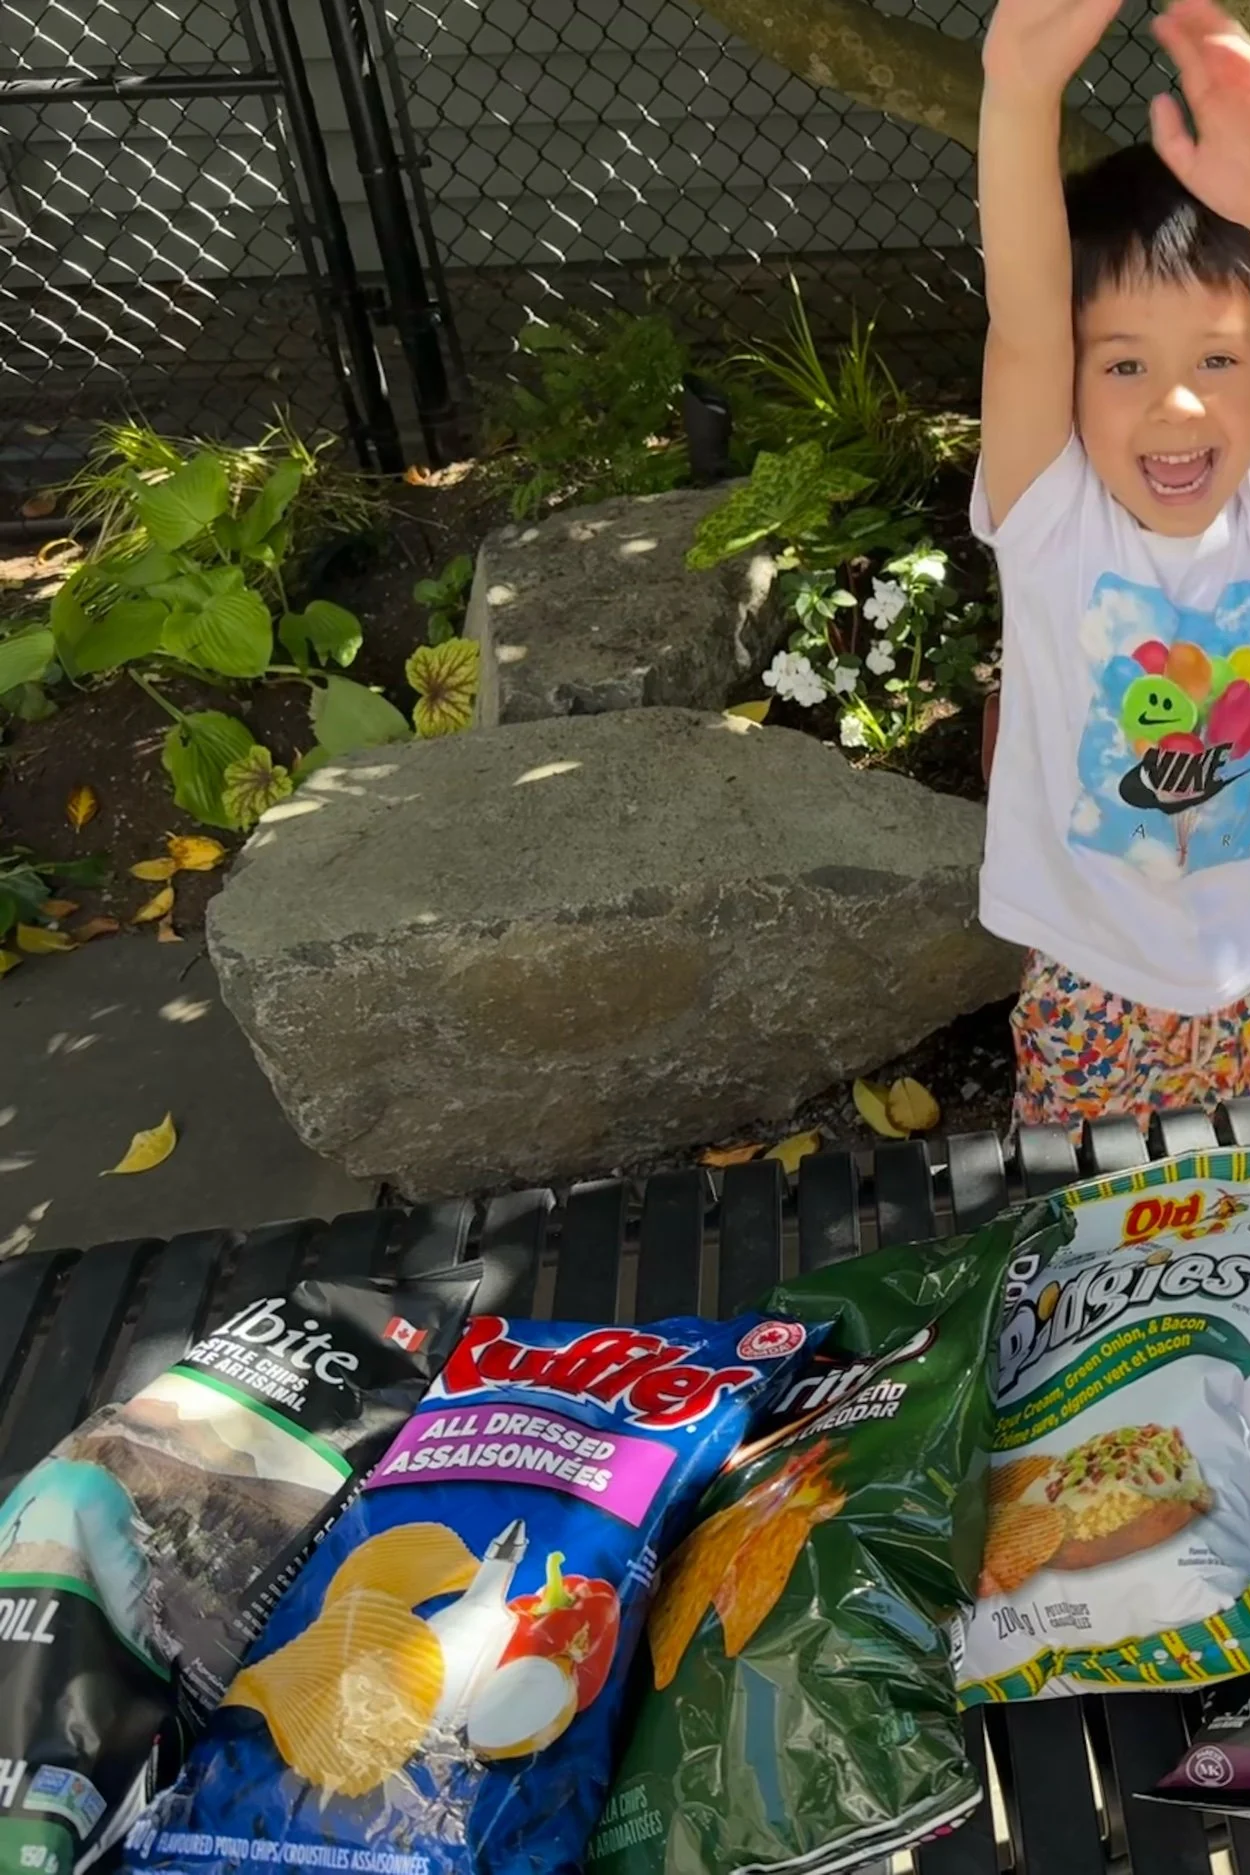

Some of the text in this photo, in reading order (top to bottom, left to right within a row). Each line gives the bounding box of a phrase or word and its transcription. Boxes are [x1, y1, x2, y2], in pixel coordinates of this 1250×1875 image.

[1148, 742, 1232, 793] NIKE
[1124, 1189, 1203, 1238] Old
[255, 1358, 310, 1391] CHIPS
[1060, 1381, 1104, 1419] oignon
[1103, 1361, 1132, 1386] vert
[1133, 1351, 1147, 1368] et
[1147, 1333, 1192, 1358] bacon
[1064, 1353, 1102, 1389] Green
[1100, 1327, 1147, 1358] Onion,
[1148, 1320, 1160, 1335] &
[1161, 1316, 1206, 1333] Bacon
[214, 1358, 308, 1413] ARTISANAL
[418, 1412, 616, 1461] ALL DRESSED
[381, 1442, 613, 1492] ASSAISONNÉES
